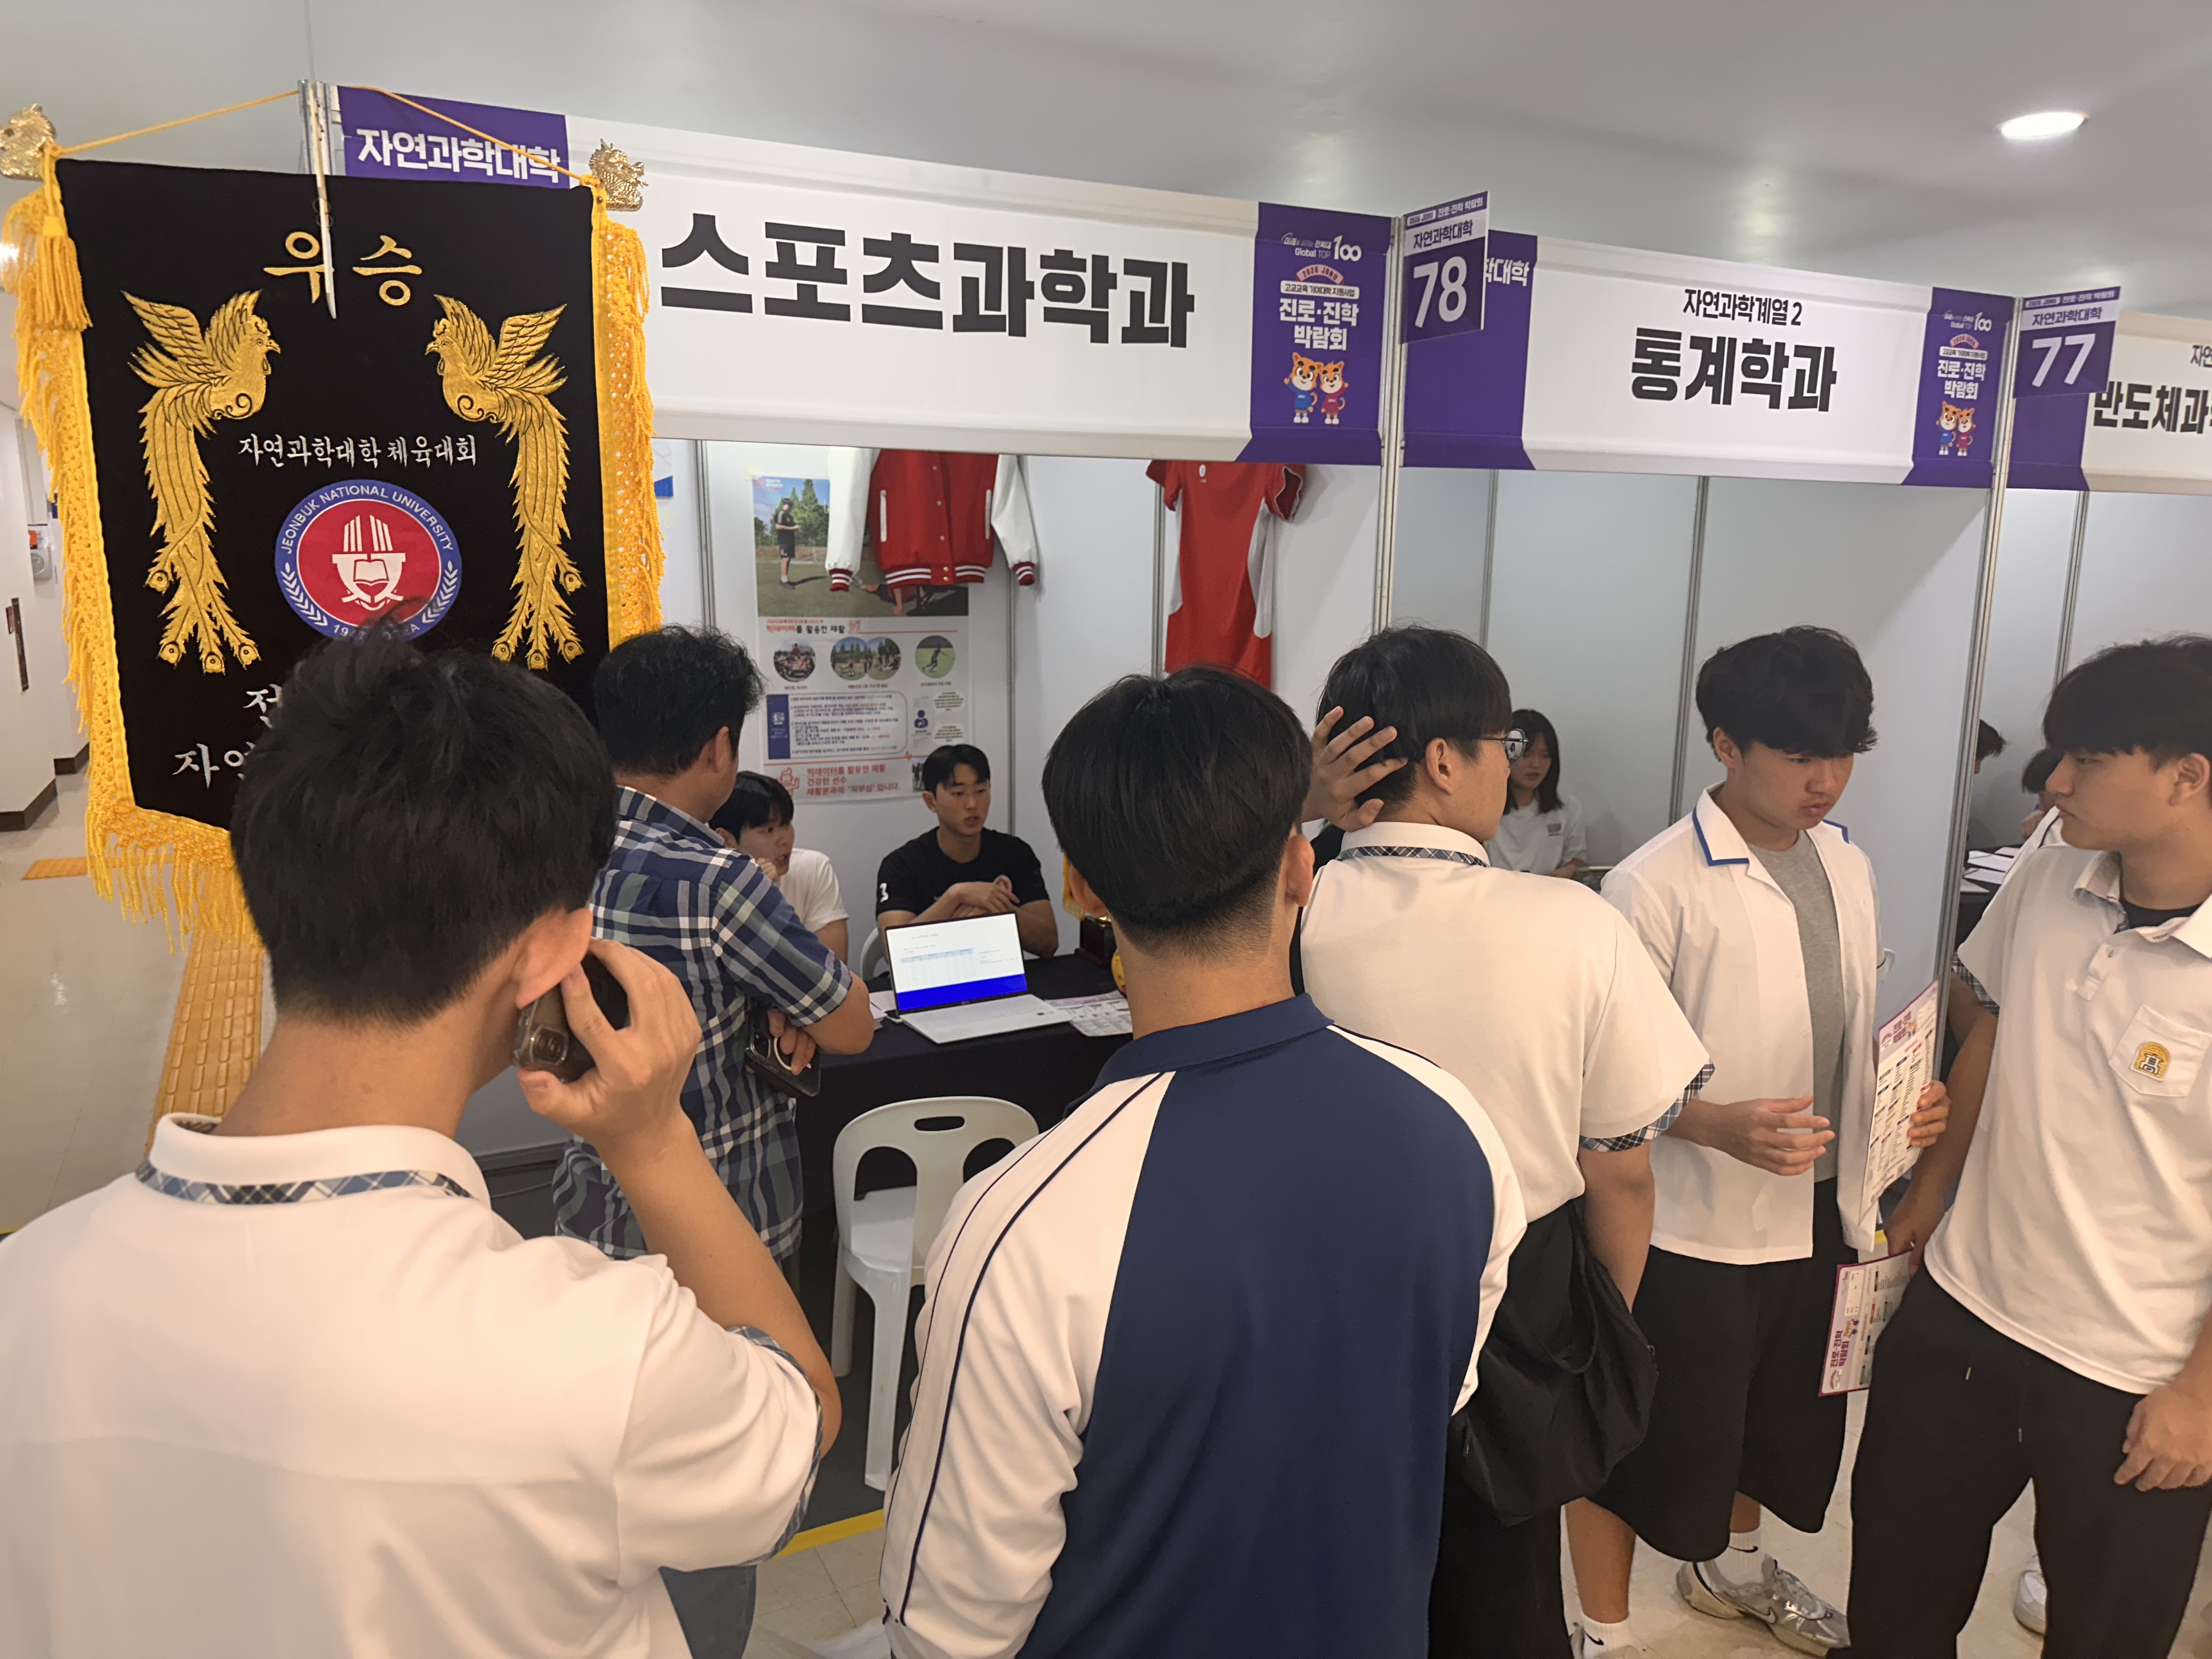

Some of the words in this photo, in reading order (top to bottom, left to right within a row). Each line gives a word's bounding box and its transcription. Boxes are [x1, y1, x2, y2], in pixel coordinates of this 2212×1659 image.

[358, 129, 560, 183] 자연과학대학
[1413, 219, 1473, 249] 자연과학대학
[263, 231, 422, 306] 우승
[660, 212, 1195, 349] 스포츠과학과
[1413, 256, 1467, 328] 78
[1683, 289, 1789, 326] 자연과학계열
[1790, 301, 1803, 326] 2
[1279, 298, 1359, 327] 진로·진학
[2032, 307, 2102, 326] 자연과학대학
[1294, 325, 1347, 351] 박람회
[1632, 327, 1837, 412] 통계학과
[1937, 359, 1986, 381] 진로·진학
[2032, 333, 2096, 387] 77
[1944, 380, 1979, 400] 박람회
[2093, 381, 2212, 434] 반도체과
[238, 433, 381, 469] 자연과학대학
[387, 434, 477, 469] 체육대회
[281, 499, 320, 554] JEONBUK
[321, 485, 388, 504] NATIONAL
[392, 491, 454, 550] UNIVERSITY
[806, 625, 827, 634] 활용한
[831, 625, 845, 634] 재활
